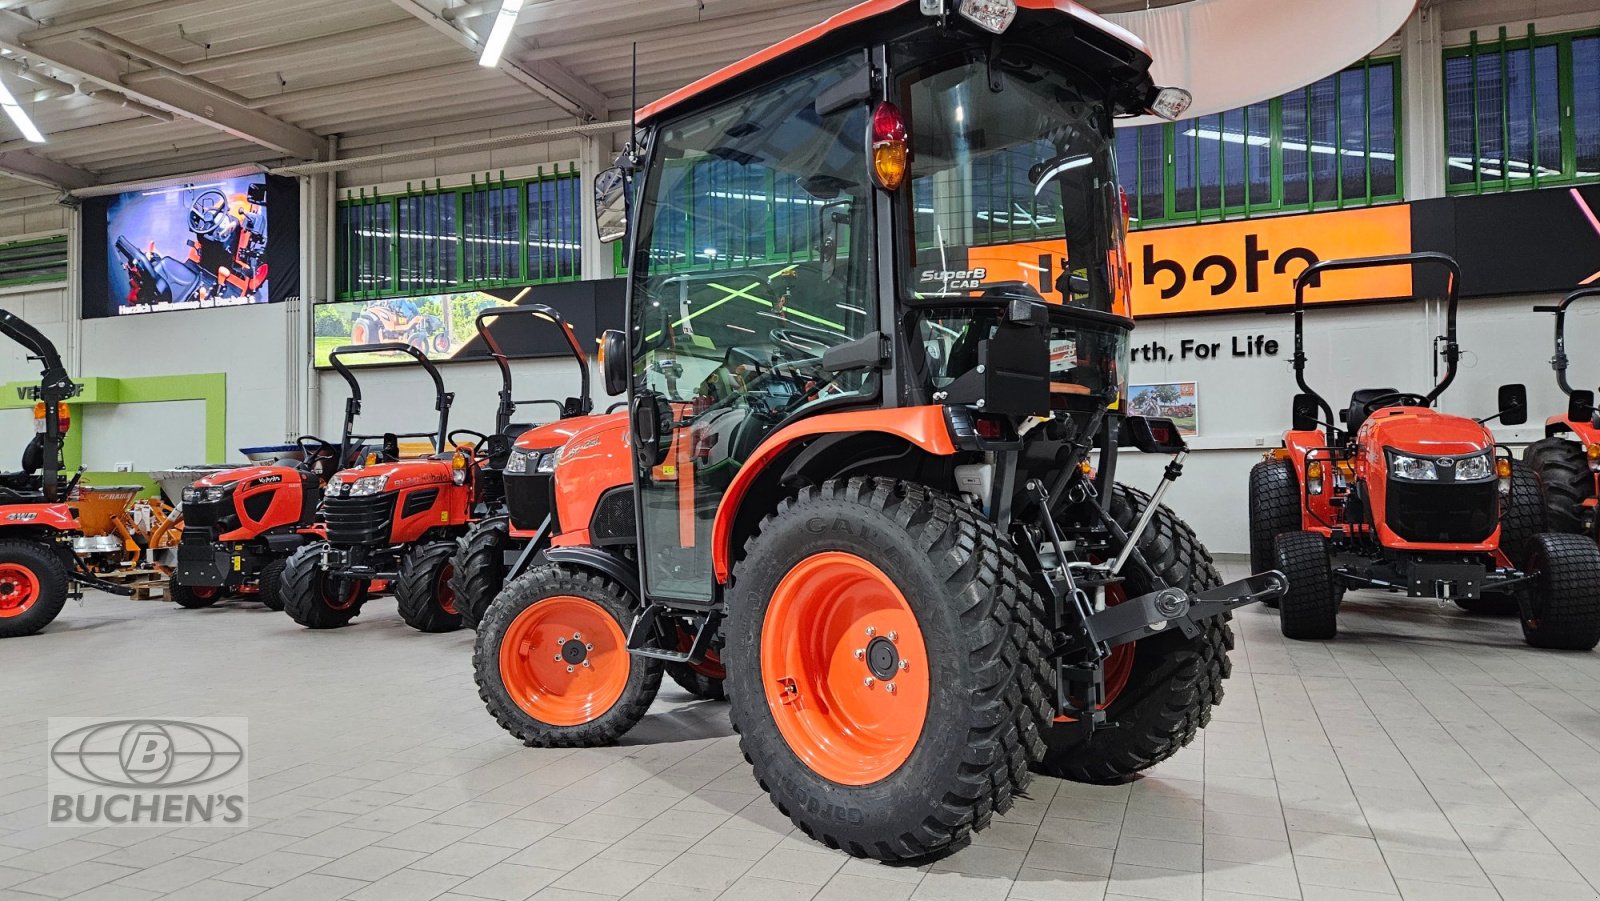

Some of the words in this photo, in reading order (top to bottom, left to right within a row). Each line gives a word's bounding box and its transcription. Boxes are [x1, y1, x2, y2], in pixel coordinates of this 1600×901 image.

[920, 268, 986, 283] SuperB
[950, 280, 979, 289] CAB
[1130, 341, 1174, 362] rth,
[1180, 339, 1221, 359] For
[1232, 335, 1279, 357] Life
